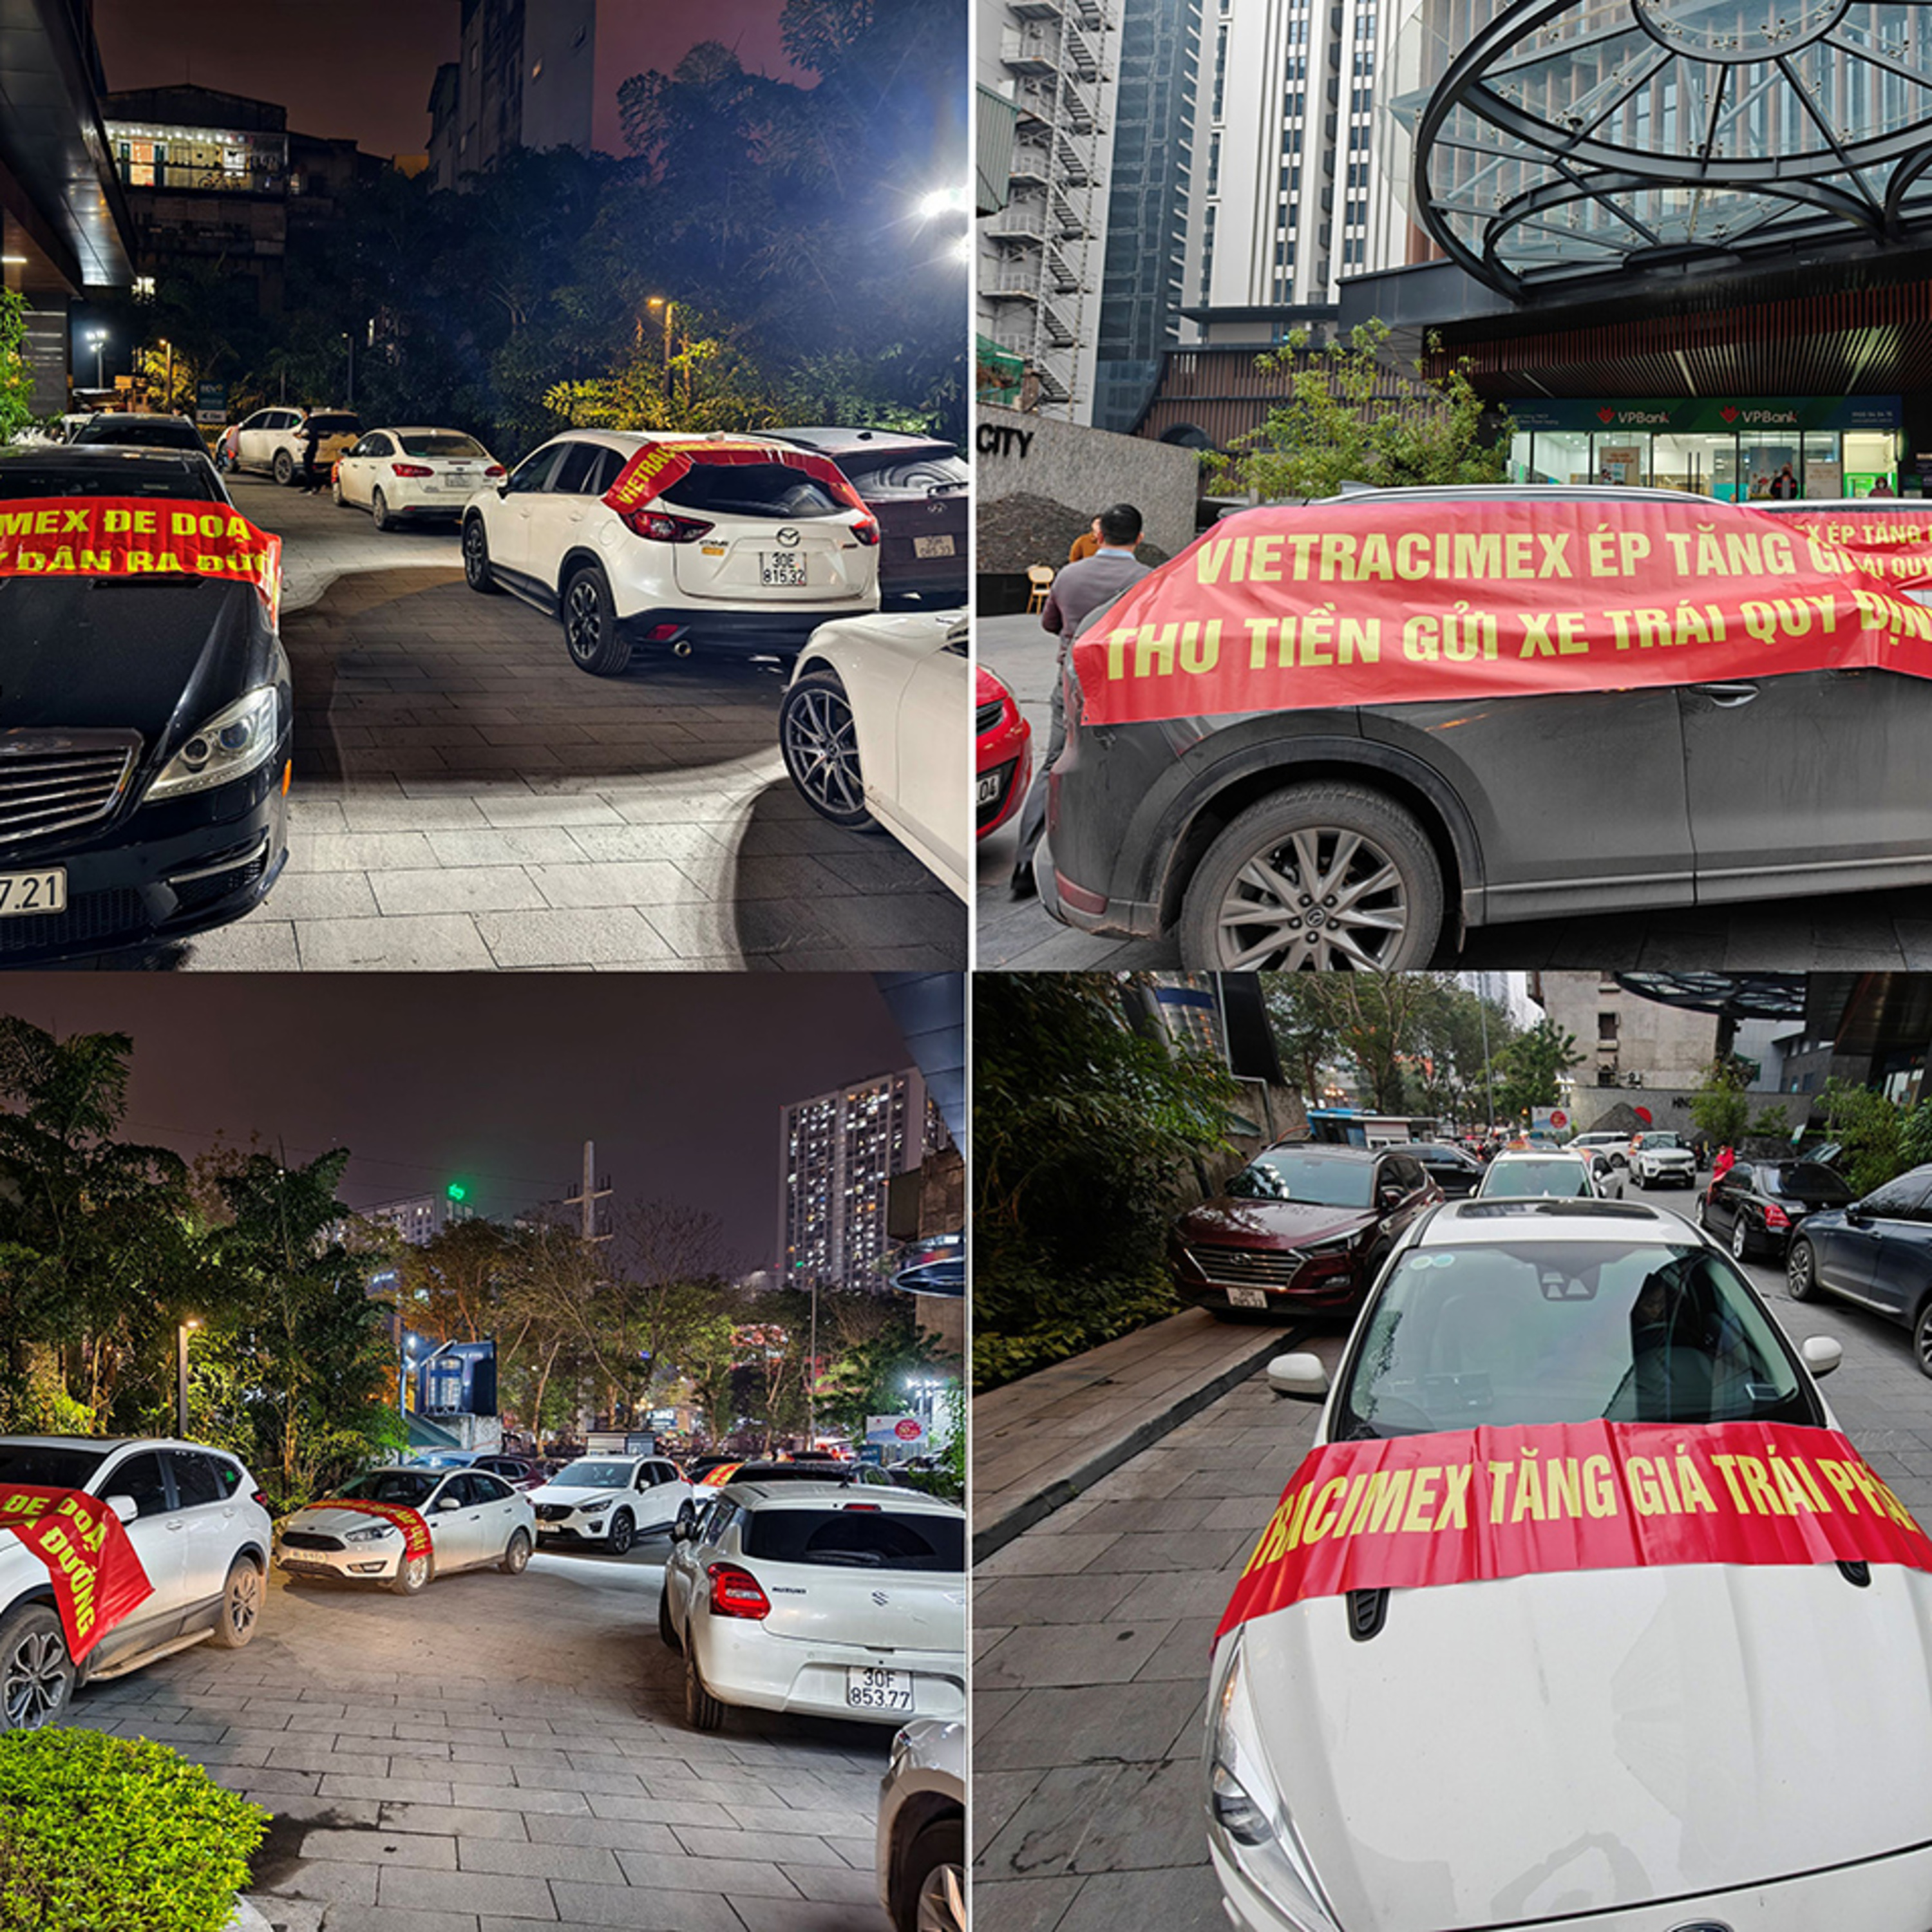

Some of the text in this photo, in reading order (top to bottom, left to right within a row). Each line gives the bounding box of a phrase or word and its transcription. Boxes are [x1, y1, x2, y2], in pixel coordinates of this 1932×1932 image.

[1618, 411, 1670, 423] VPBank
[1742, 410, 1799, 423] VPBank
[976, 422, 1034, 459] CITY
[103, 509, 156, 534] ĐE
[171, 513, 252, 543] DOẠ
[1827, 520, 1855, 545] ÉP
[1861, 520, 1922, 545] TĂNG
[16, 545, 112, 573] DÂN
[127, 551, 185, 573] RA
[1197, 533, 1573, 584] VIETRACIMEX
[1587, 523, 1652, 577] ÉP
[1665, 524, 1797, 576] TĂNG
[1105, 619, 1223, 680] THU
[1244, 602, 1381, 669] TIỀN
[1403, 600, 1499, 661] GỬI
[1518, 612, 1589, 658] XE
[1604, 600, 1727, 650] TRÁI
[1739, 594, 1837, 645] QUY
[1488, 1446, 1618, 1525] TĂNG
[1625, 1444, 1718, 1517] GIÁ
[1710, 1444, 1832, 1517] TRÁI
[863, 1667, 896, 1688] 30F
